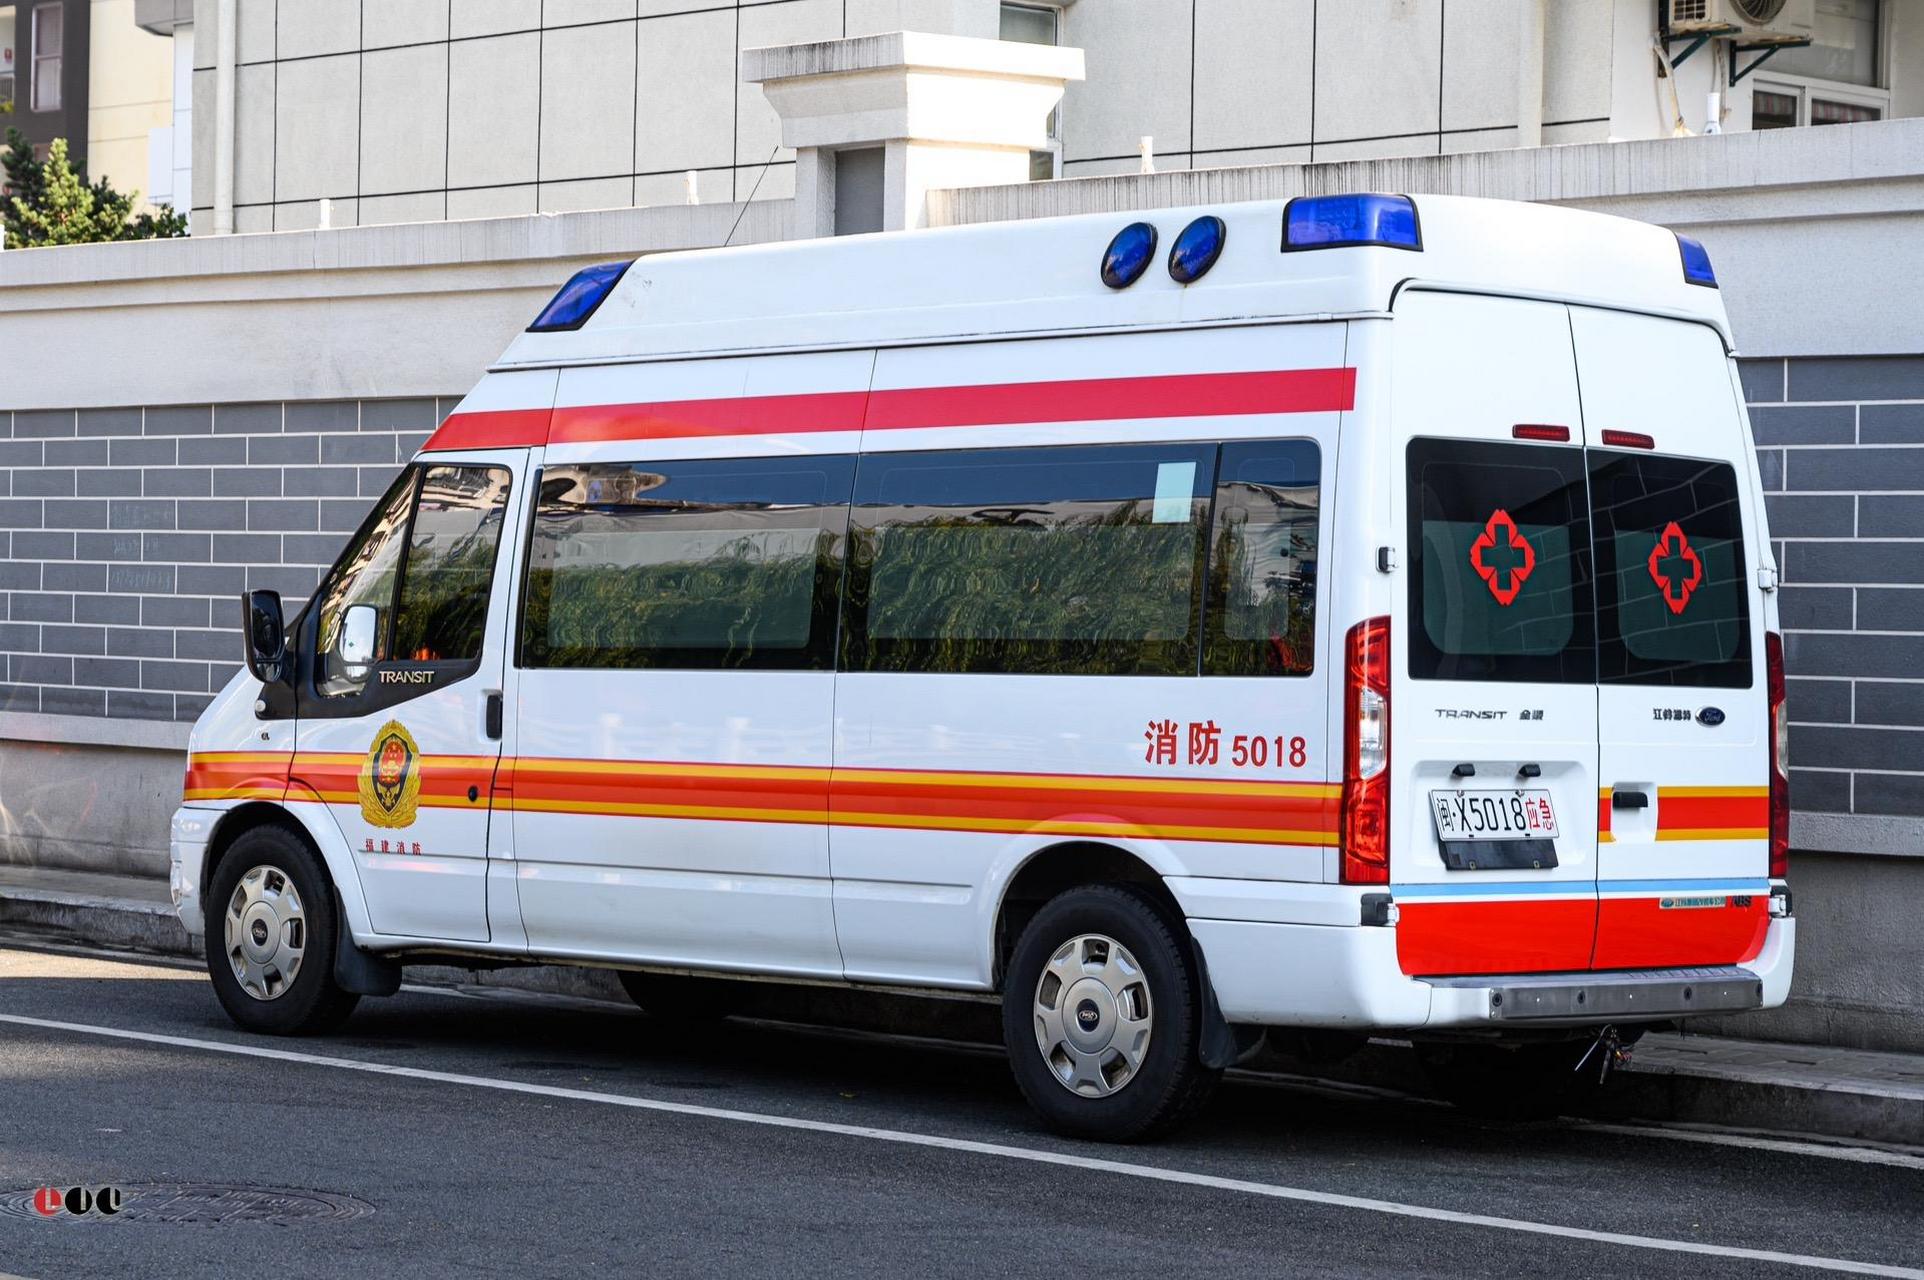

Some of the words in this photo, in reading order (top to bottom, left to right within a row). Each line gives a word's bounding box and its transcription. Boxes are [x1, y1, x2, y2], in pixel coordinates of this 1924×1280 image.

[379, 670, 434, 684] TRANSIT
[1434, 708, 1508, 720] TRANSIT
[1144, 719, 1222, 766] 消防
[1231, 735, 1308, 768] 5018
[365, 837, 421, 856] 福建消防
